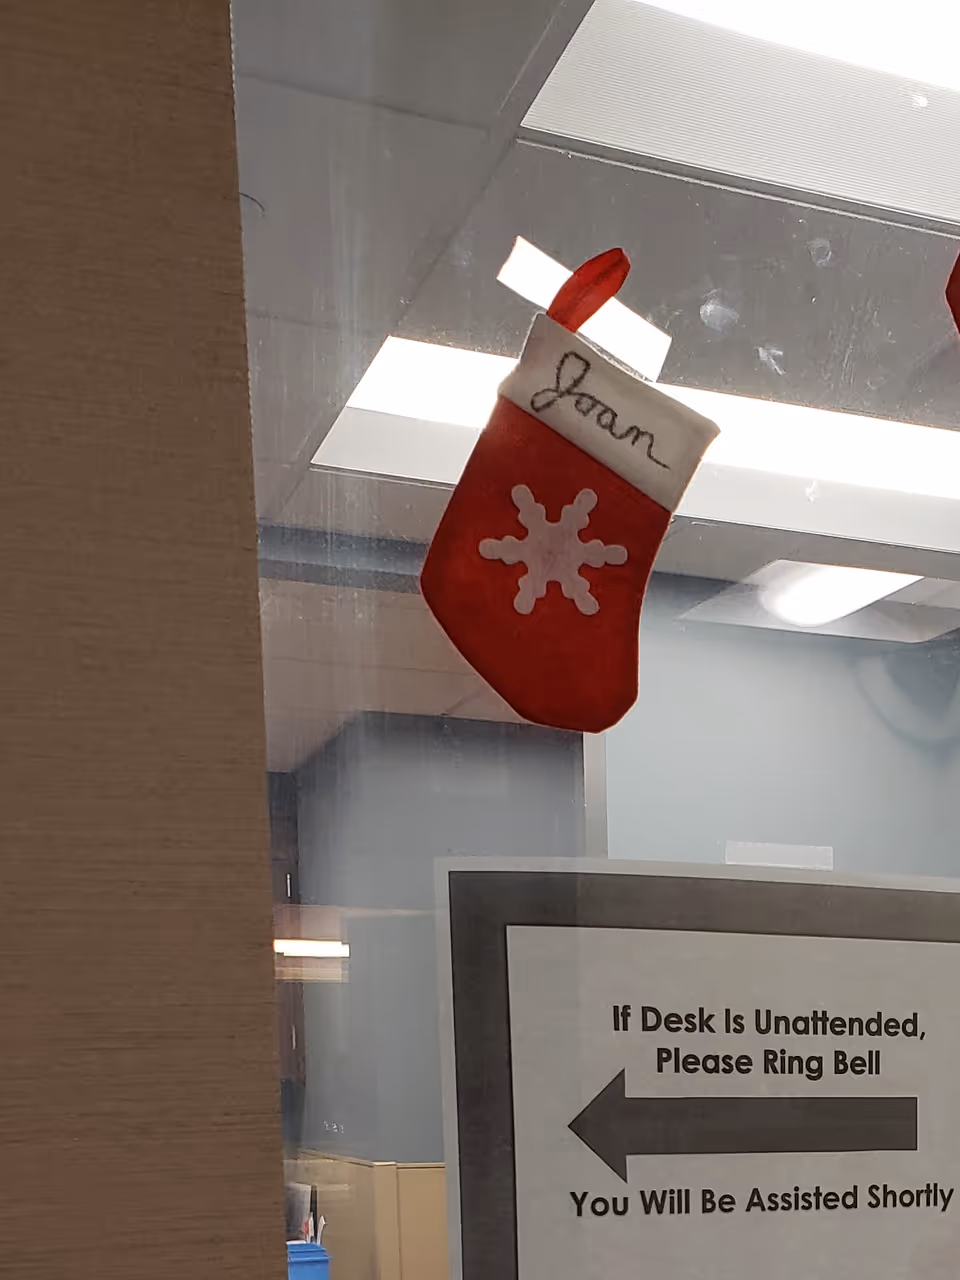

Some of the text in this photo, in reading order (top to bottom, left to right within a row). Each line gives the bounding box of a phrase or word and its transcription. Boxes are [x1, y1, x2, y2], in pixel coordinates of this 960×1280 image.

[531, 351, 671, 470] Joan
[613, 1005, 927, 1040] If Desk Is Unattended,
[656, 1047, 882, 1081] Please Ring Bell
[570, 1182, 955, 1217] You Will Be Assisted Shortly
